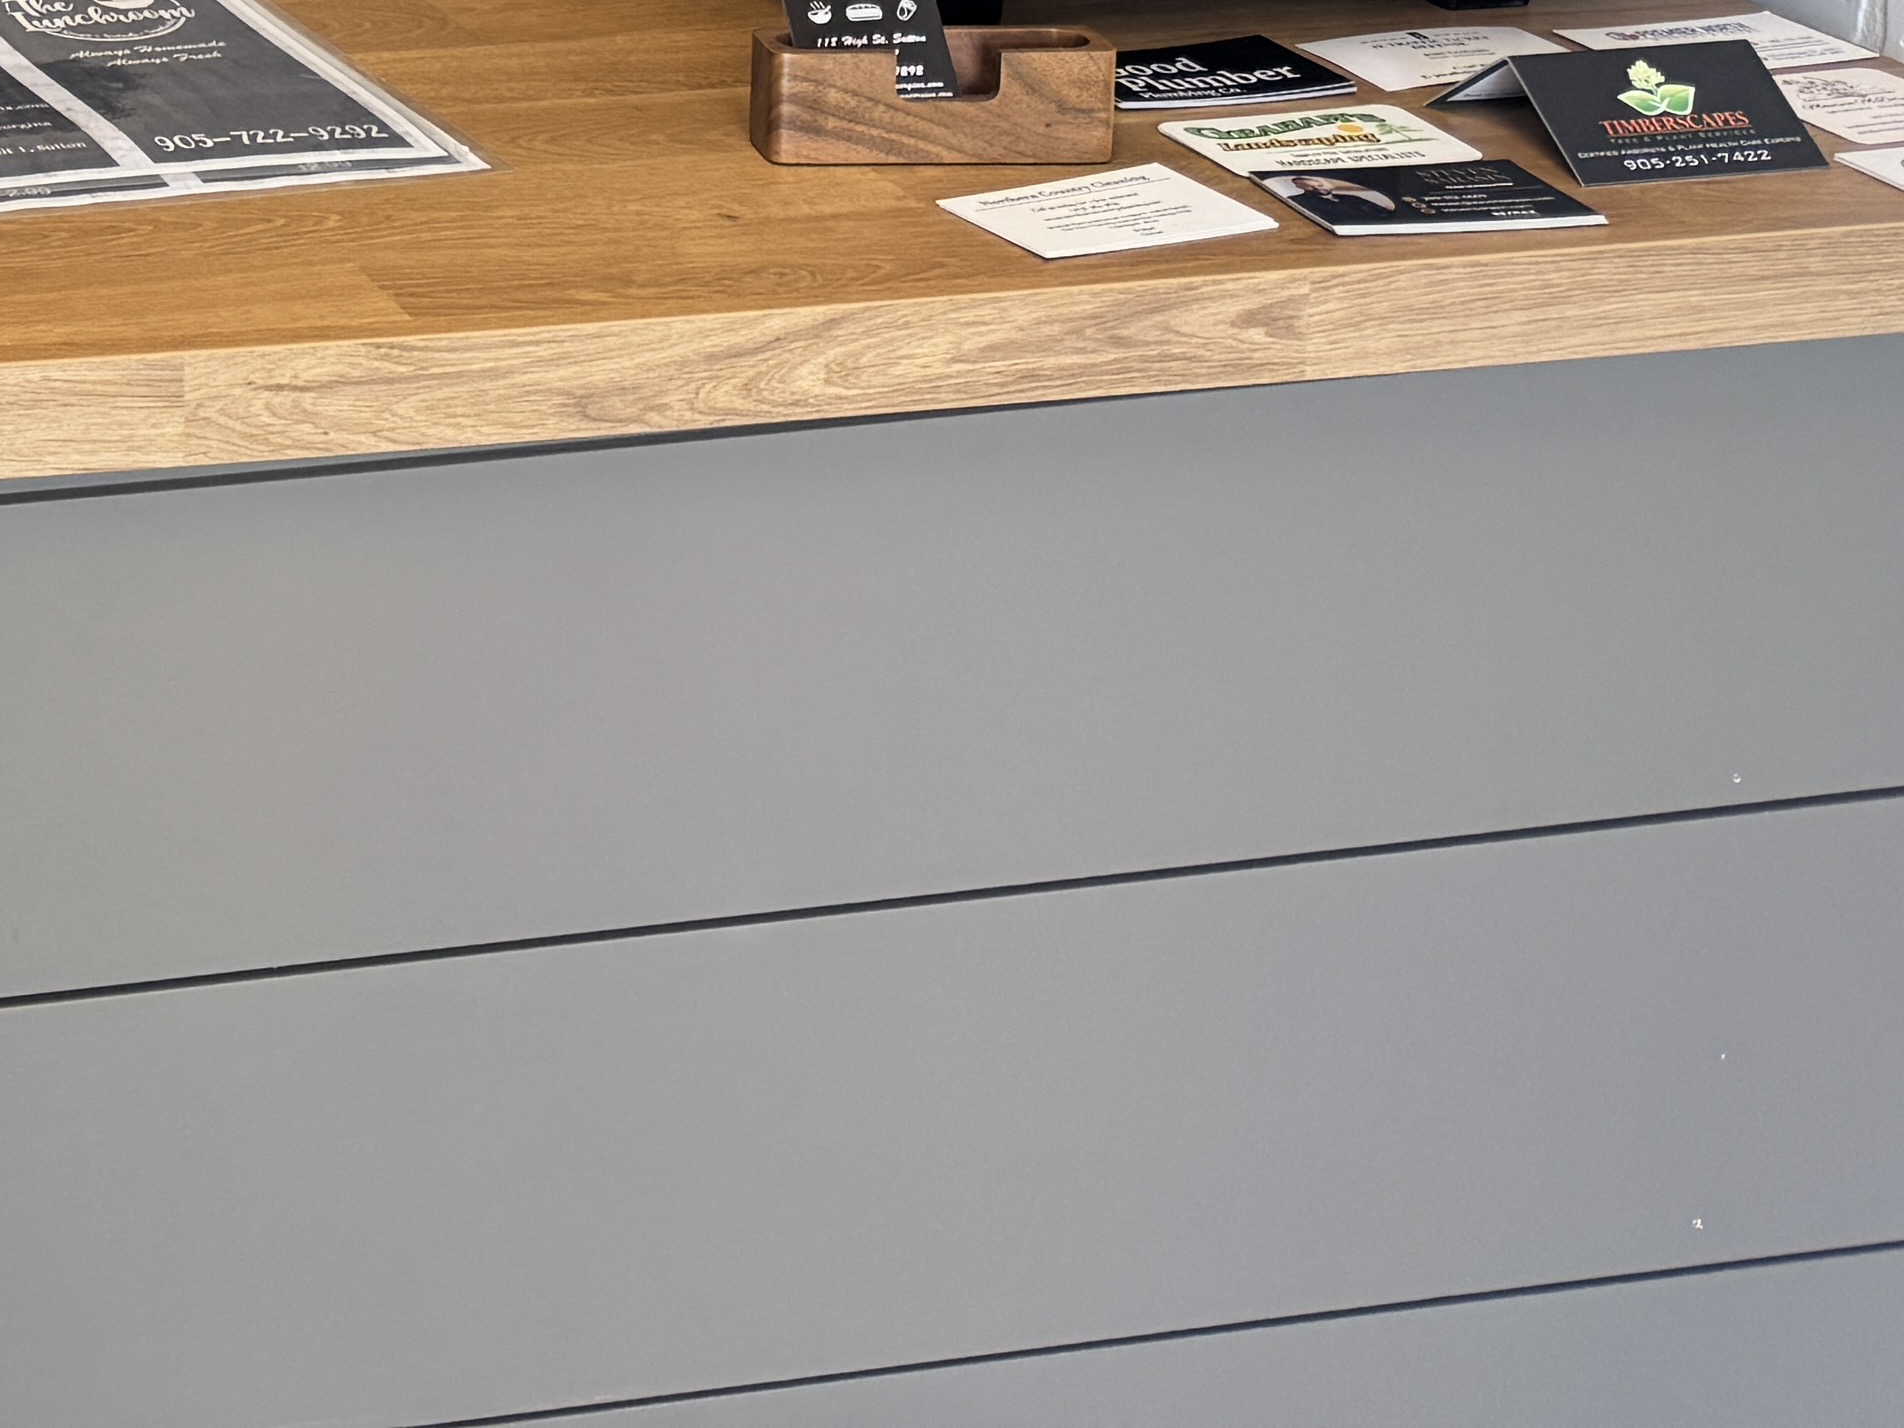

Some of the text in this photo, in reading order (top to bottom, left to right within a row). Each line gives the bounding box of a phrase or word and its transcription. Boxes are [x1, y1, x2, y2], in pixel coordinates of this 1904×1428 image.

[7, 6, 196, 33] Lunchroom
[70, 40, 226, 60] Always Homemade
[842, 34, 869, 48] High
[107, 50, 222, 67] Always Fresh
[1115, 56, 1208, 77] ood
[1115, 65, 1302, 93] Plumber
[1598, 110, 1751, 137] TIMBERSCAPES
[38, 141, 87, 151] Sutton
[154, 124, 390, 152] 905-722-9292
